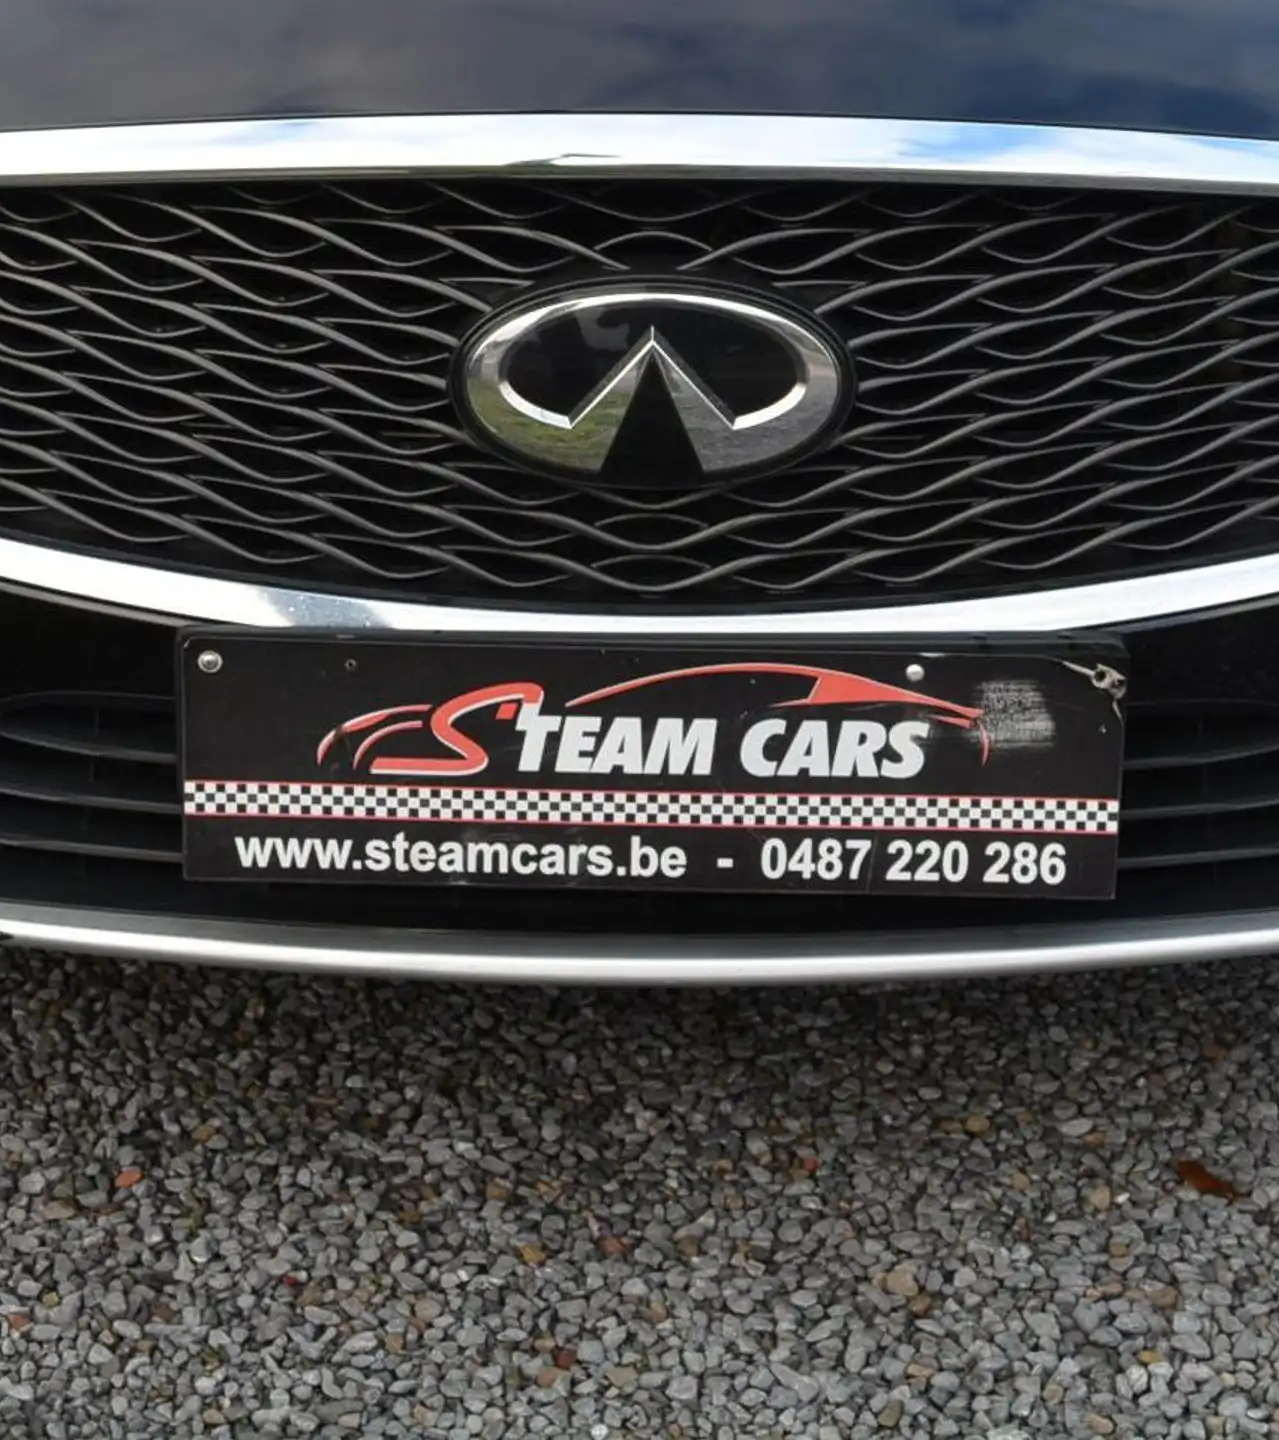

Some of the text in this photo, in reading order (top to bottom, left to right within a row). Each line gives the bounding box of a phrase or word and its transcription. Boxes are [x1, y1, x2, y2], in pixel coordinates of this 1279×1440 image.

[369, 681, 931, 780] STEAM CARS
[234, 830, 688, 880] www.steamcars.be
[760, 836, 872, 881] 0487
[885, 838, 969, 883] 220
[982, 840, 1066, 885] 286
